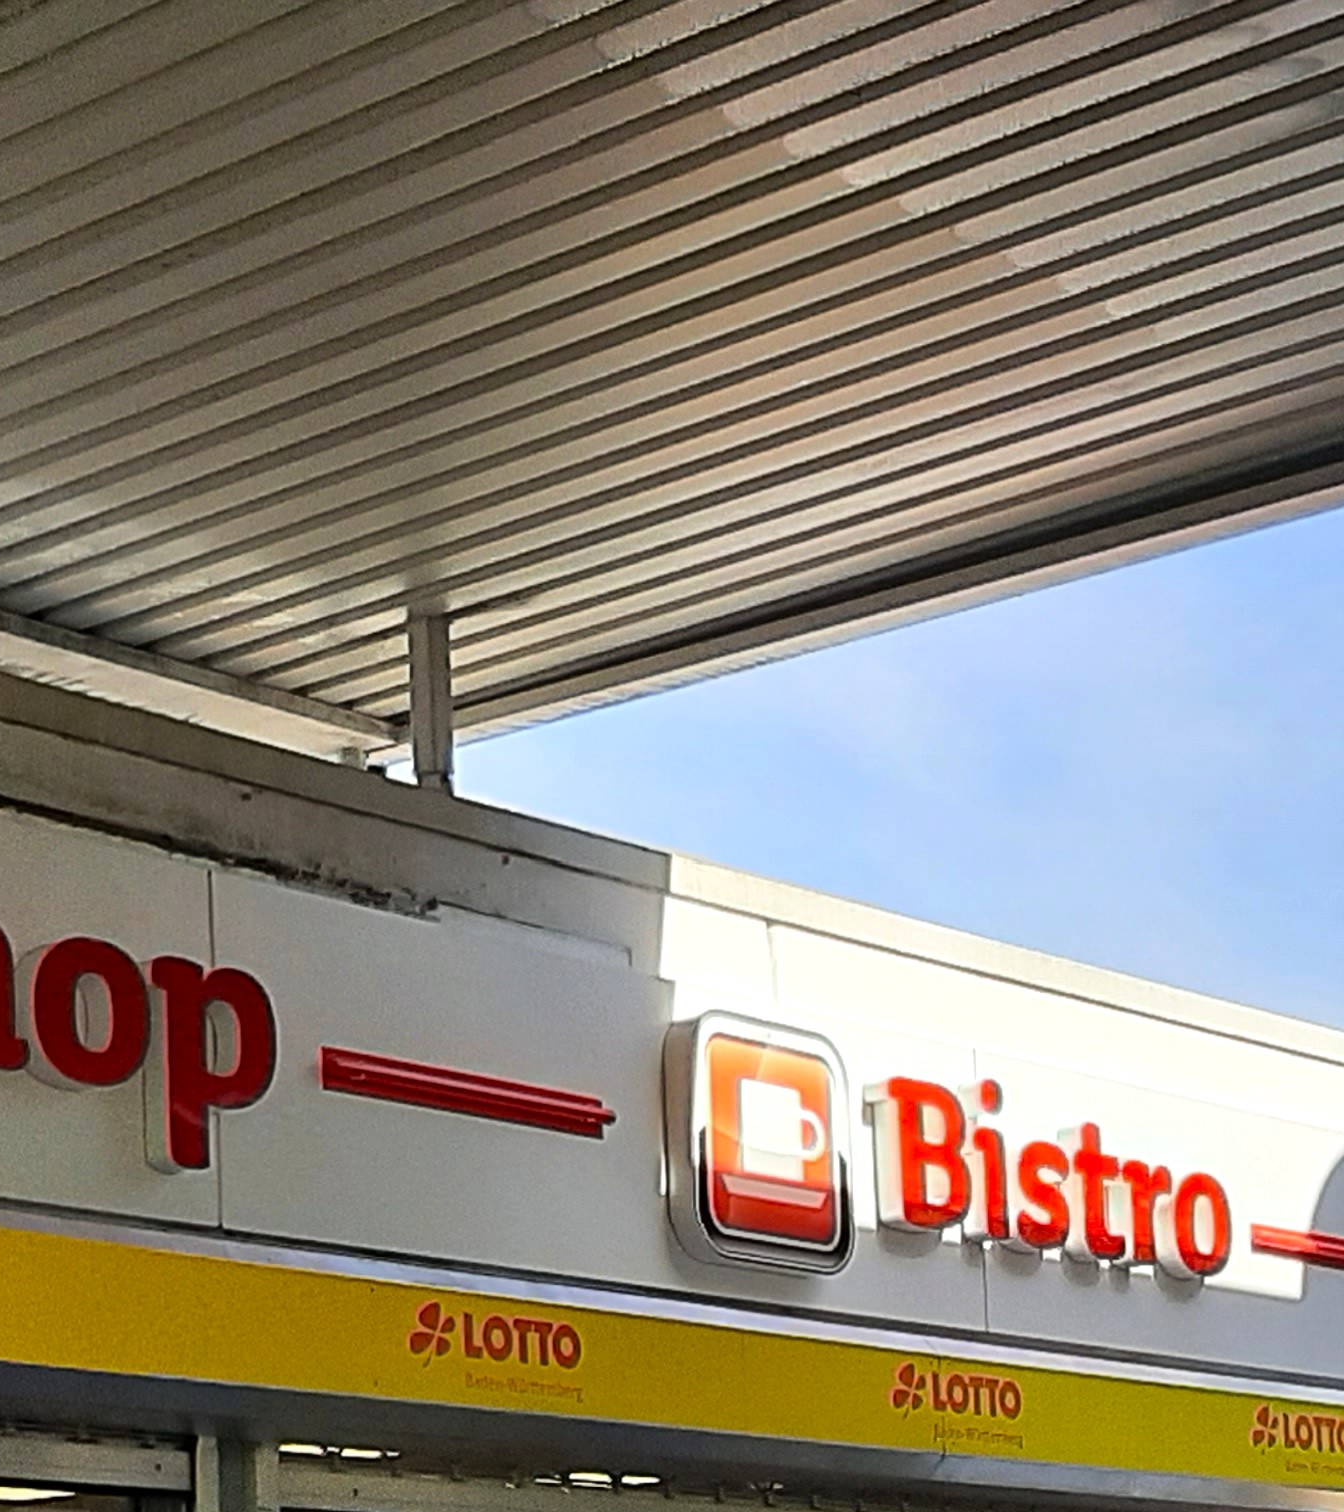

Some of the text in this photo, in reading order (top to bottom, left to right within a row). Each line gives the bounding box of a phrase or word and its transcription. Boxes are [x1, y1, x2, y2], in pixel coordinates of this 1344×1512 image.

[886, 1075, 1232, 1277] Bistro
[461, 1311, 582, 1371] LOTTO
[927, 1370, 1023, 1421] LOTTO
